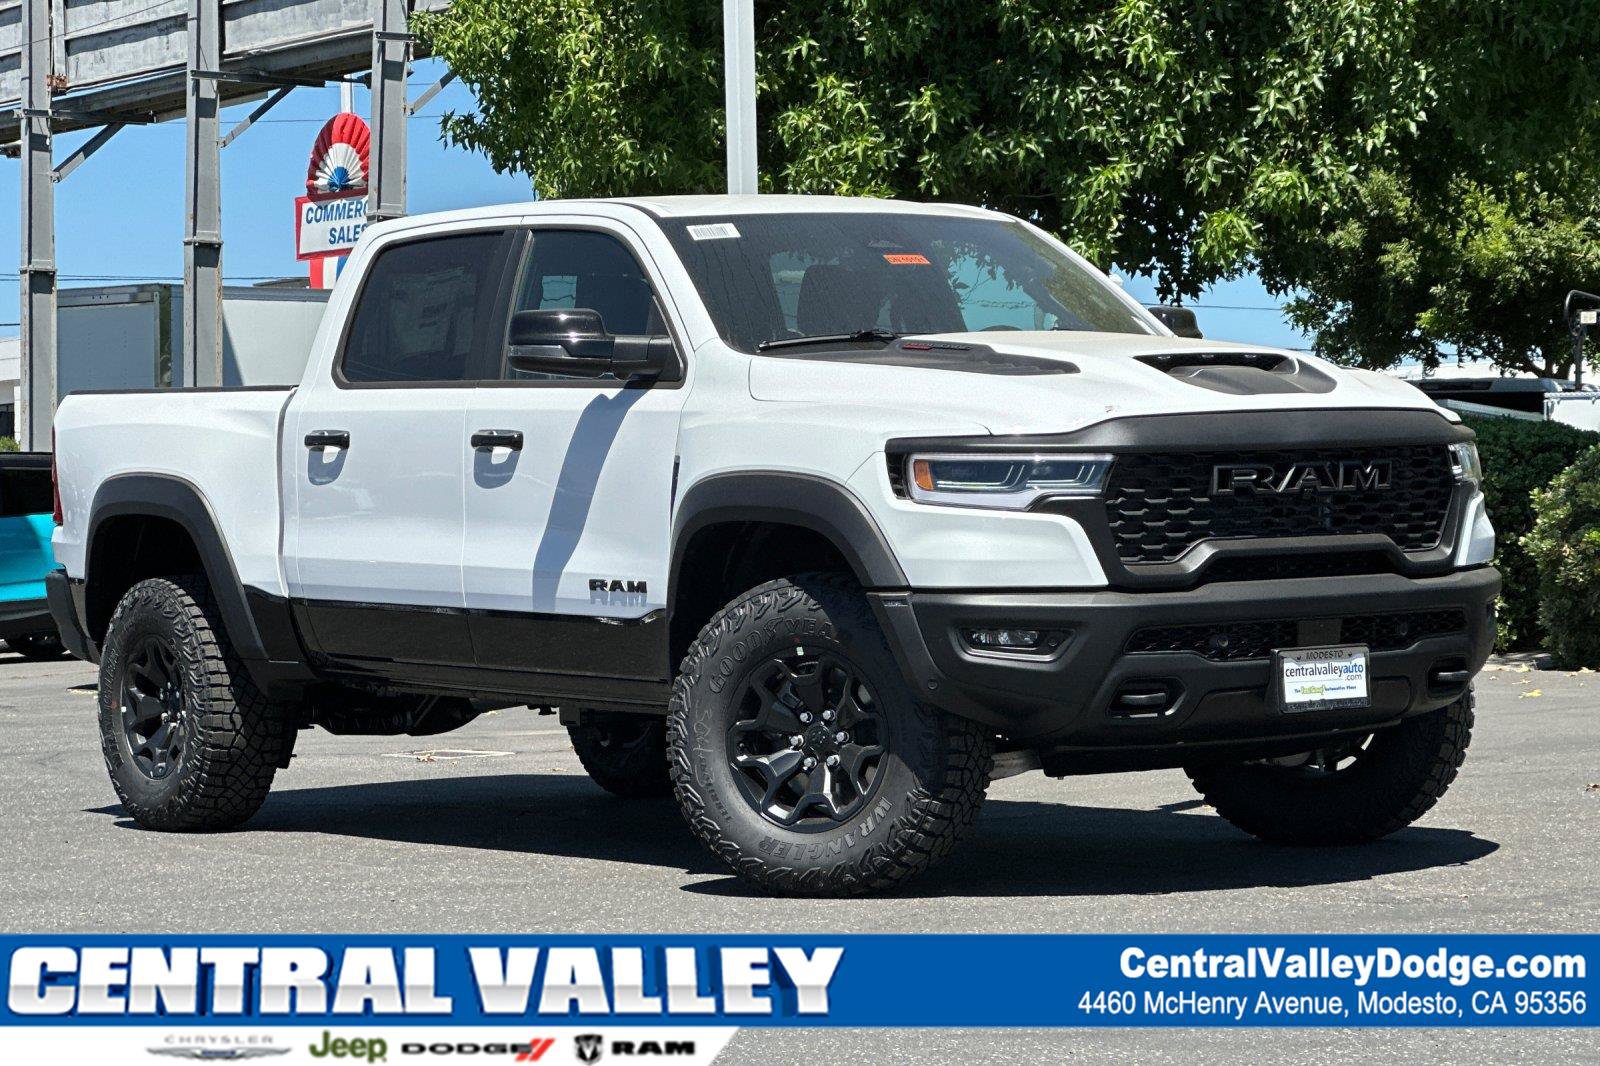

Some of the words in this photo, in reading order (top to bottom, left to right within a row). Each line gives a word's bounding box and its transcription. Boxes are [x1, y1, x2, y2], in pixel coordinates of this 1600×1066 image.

[1212, 461, 1393, 495] RAM
[589, 579, 647, 594] RAM
[709, 617, 836, 693] GOODYEA
[1306, 650, 1344, 660] MODESTO
[1285, 663, 1364, 678] centralvalleyauto
[758, 796, 893, 860] WRANGLER
